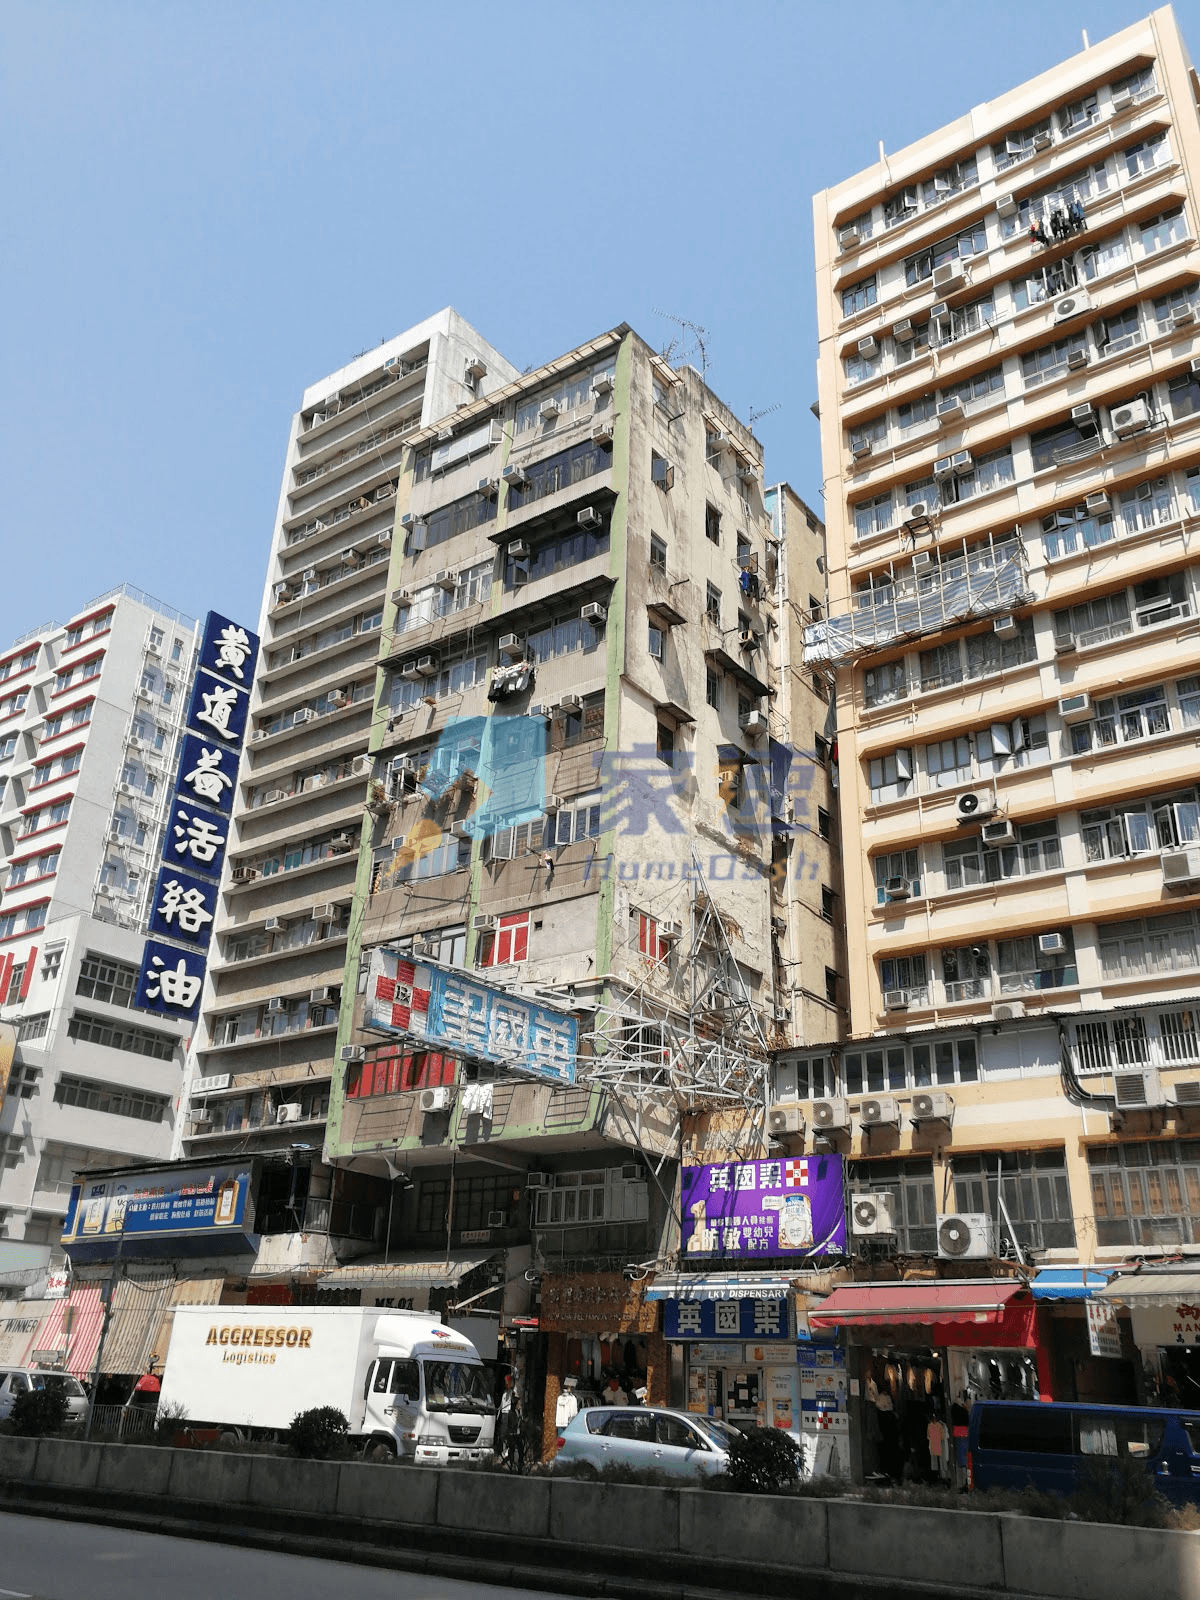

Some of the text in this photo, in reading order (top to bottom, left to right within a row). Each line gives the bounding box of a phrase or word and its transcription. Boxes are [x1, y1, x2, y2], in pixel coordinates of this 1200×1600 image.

[728, 1288, 788, 1298] DISPENSARY
[4, 1319, 39, 1334] WINNER
[205, 1326, 313, 1348] AGGRESSOR
[222, 1350, 277, 1365] Logistics
